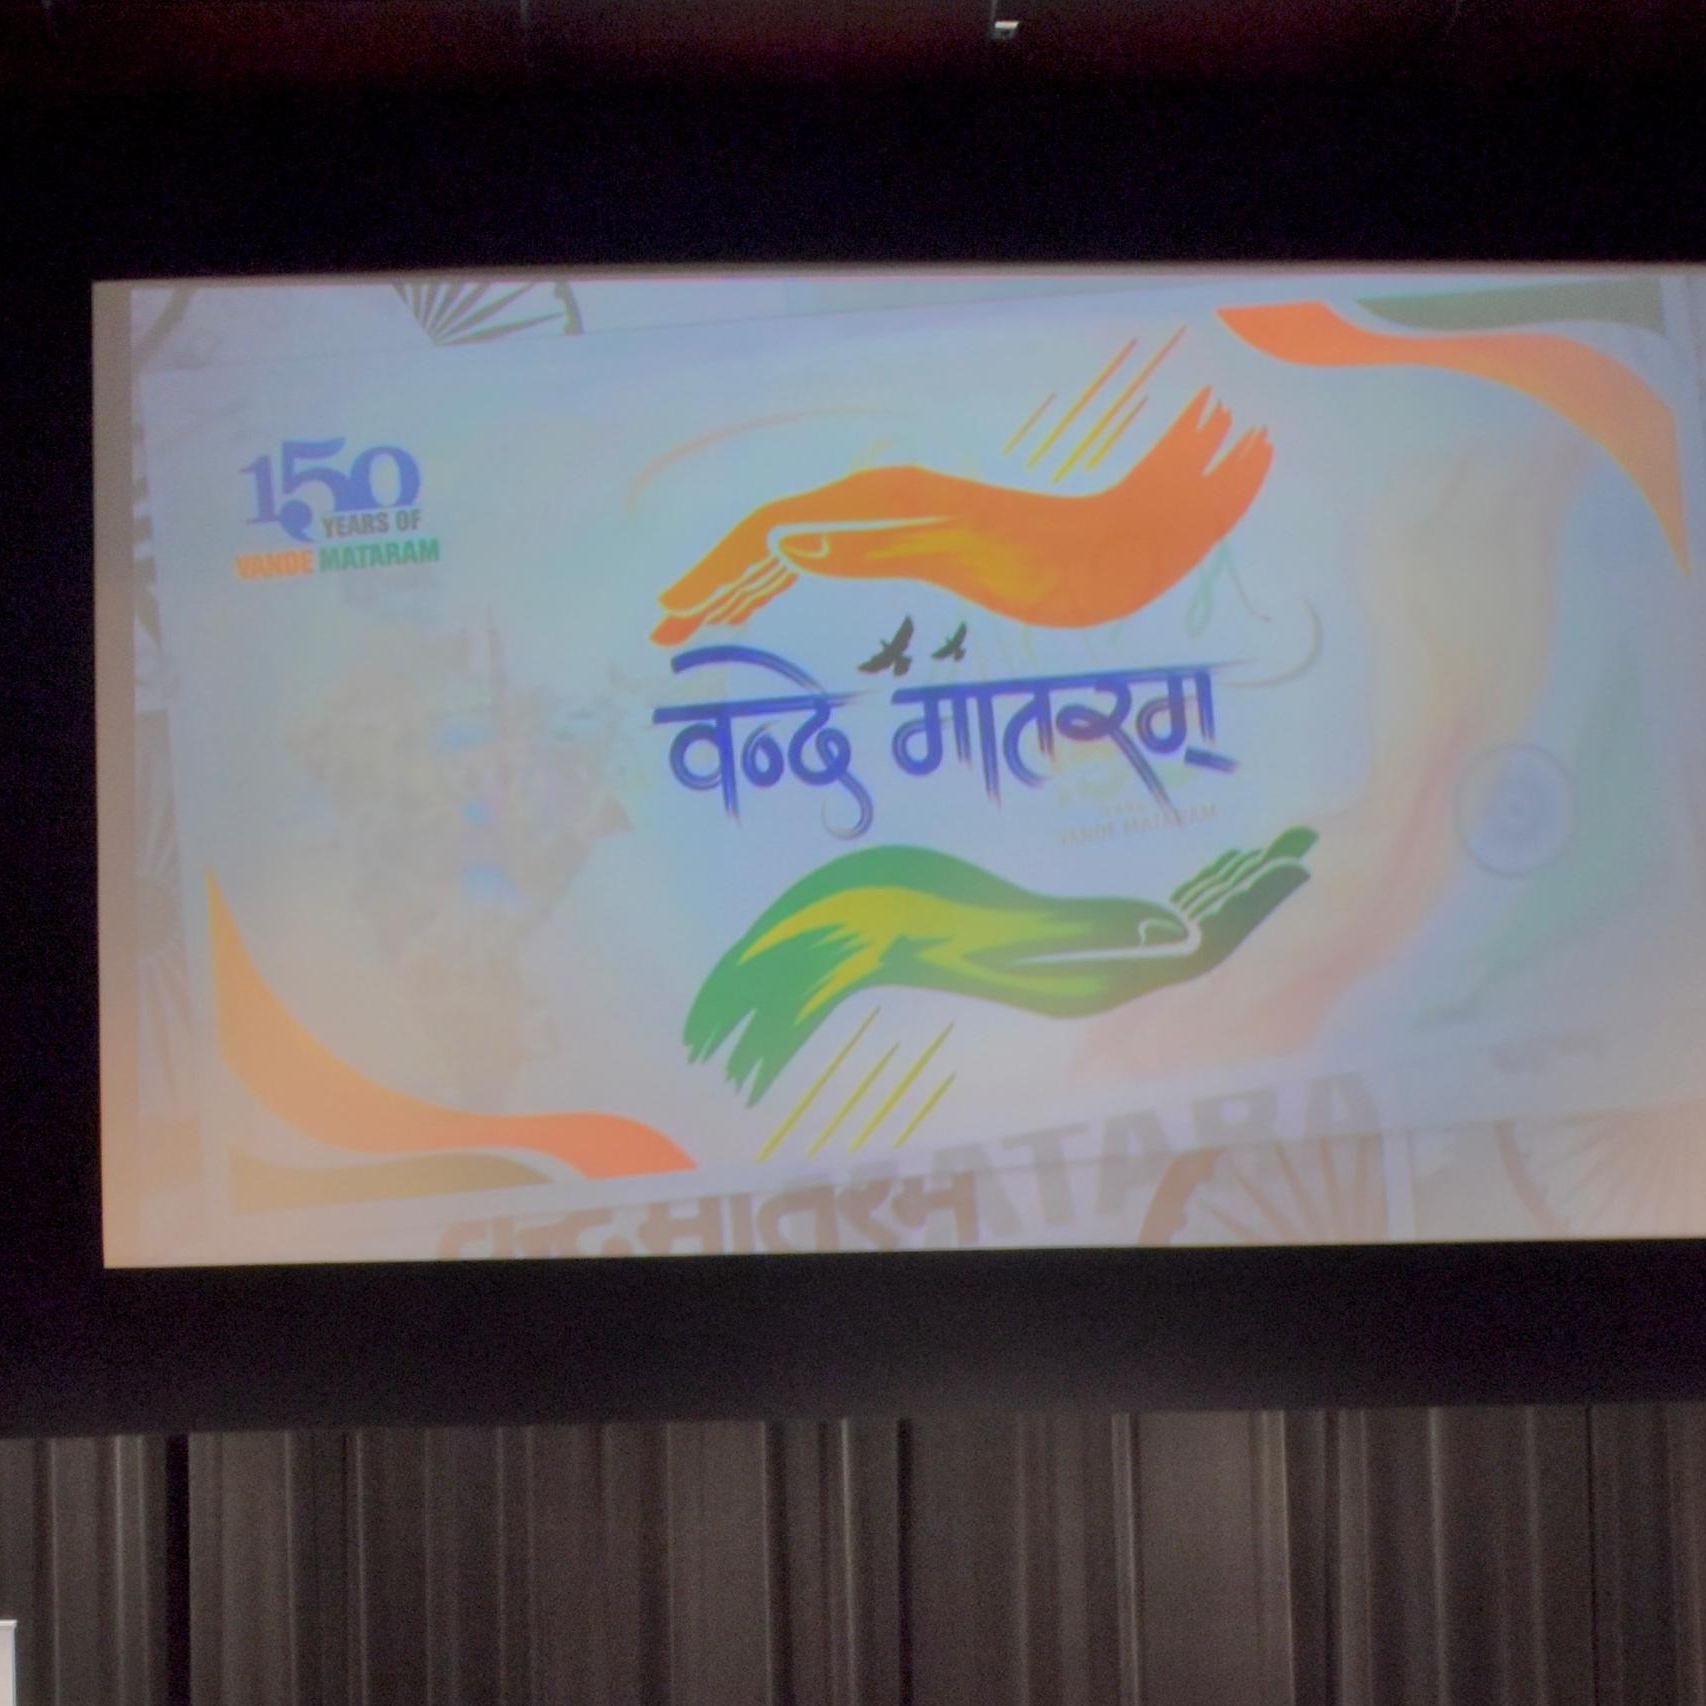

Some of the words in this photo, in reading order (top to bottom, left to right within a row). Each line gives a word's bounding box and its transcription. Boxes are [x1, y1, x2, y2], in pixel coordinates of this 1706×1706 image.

[238, 437, 421, 543] 150
[321, 512, 390, 539] YEARS
[396, 509, 422, 532] OF
[234, 548, 314, 580] VANDE
[319, 538, 440, 573] MATARAM
[651, 645, 873, 838] वन्दे
